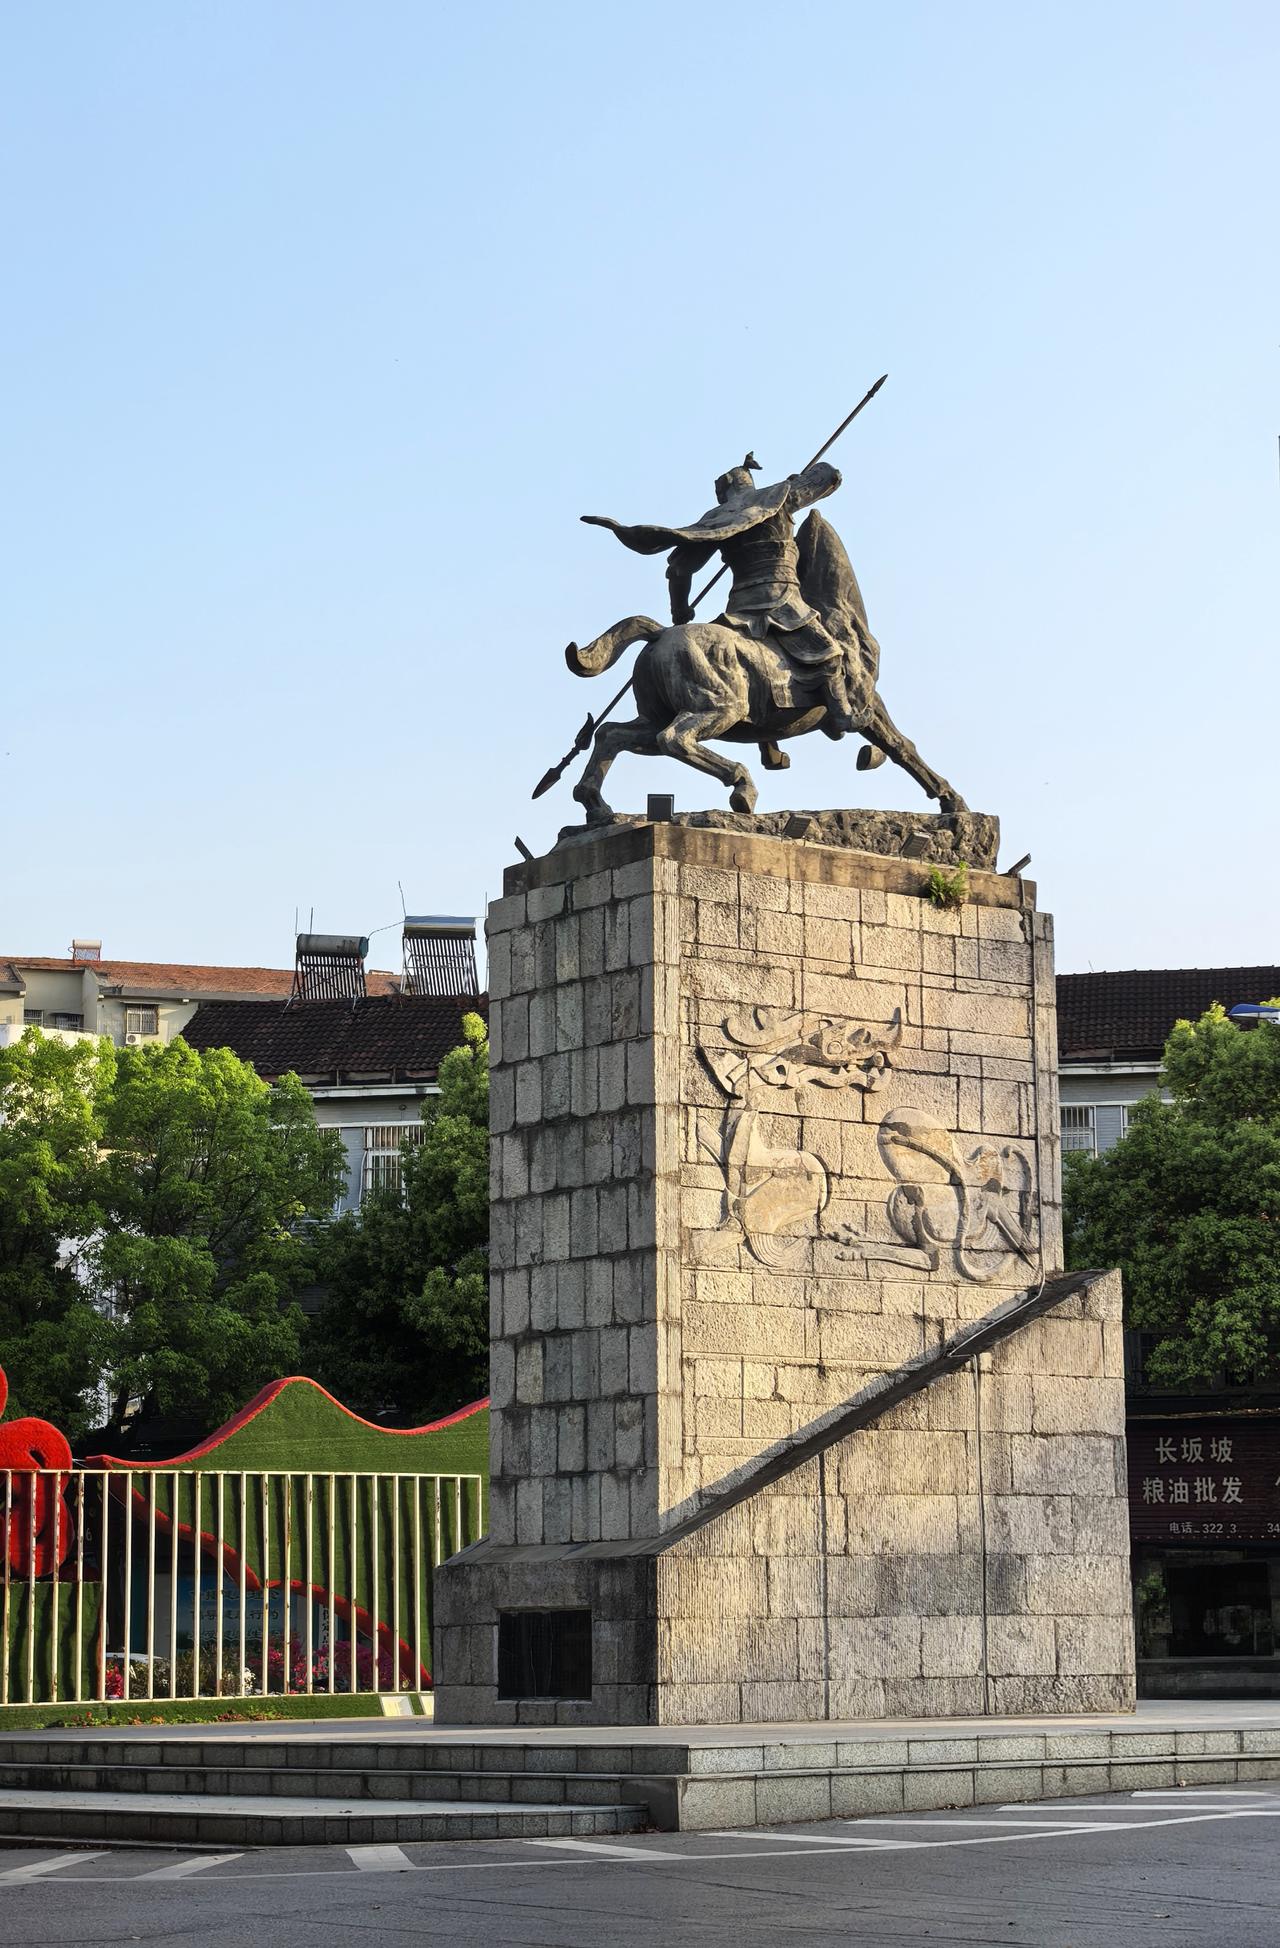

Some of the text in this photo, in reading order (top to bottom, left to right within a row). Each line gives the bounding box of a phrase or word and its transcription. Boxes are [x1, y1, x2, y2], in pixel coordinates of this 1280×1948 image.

[1155, 1436, 1233, 1463] 长坂坡
[1142, 1476, 1244, 1504] 粮油批发
